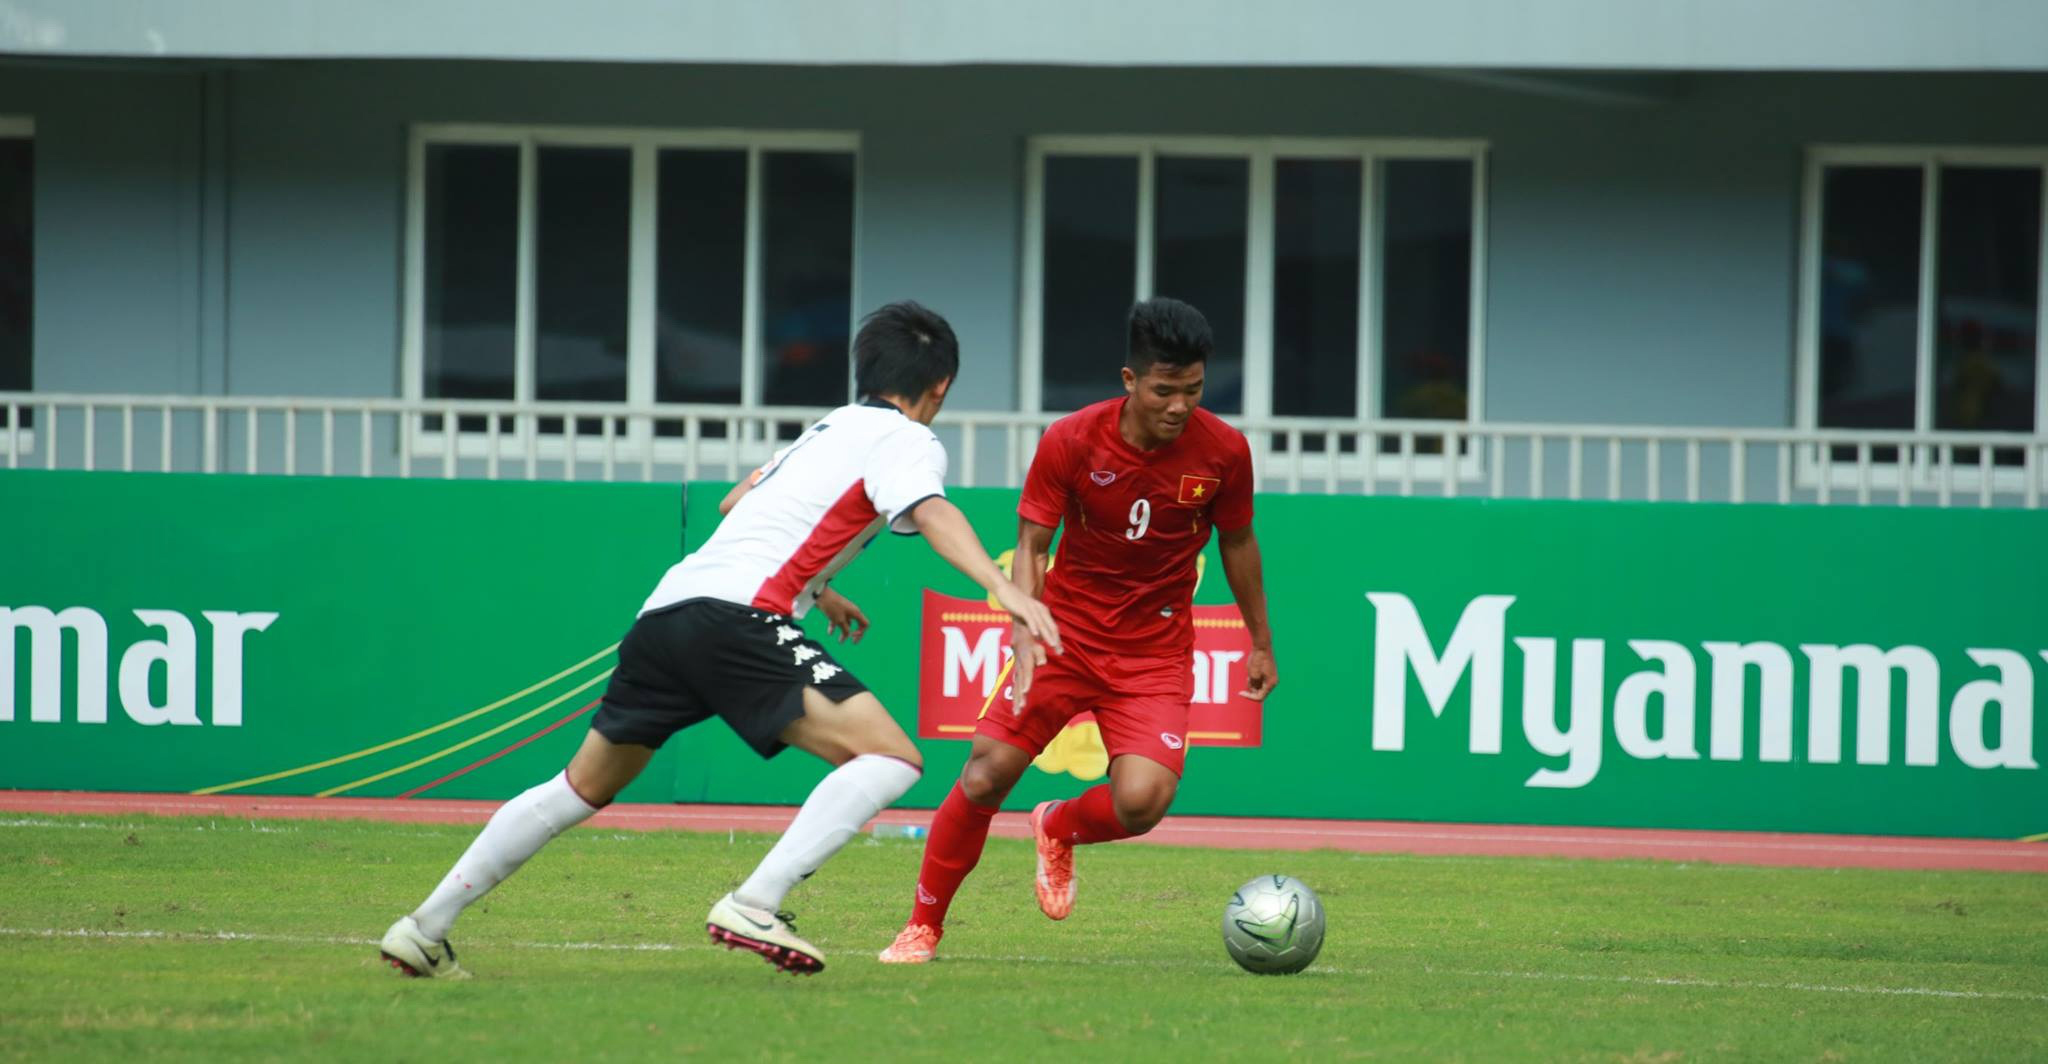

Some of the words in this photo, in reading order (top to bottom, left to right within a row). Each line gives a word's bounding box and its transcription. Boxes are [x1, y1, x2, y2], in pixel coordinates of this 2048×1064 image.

[1126, 498, 1151, 540] 9
[0, 605, 280, 726] mar
[1365, 592, 2048, 788] Myanma
